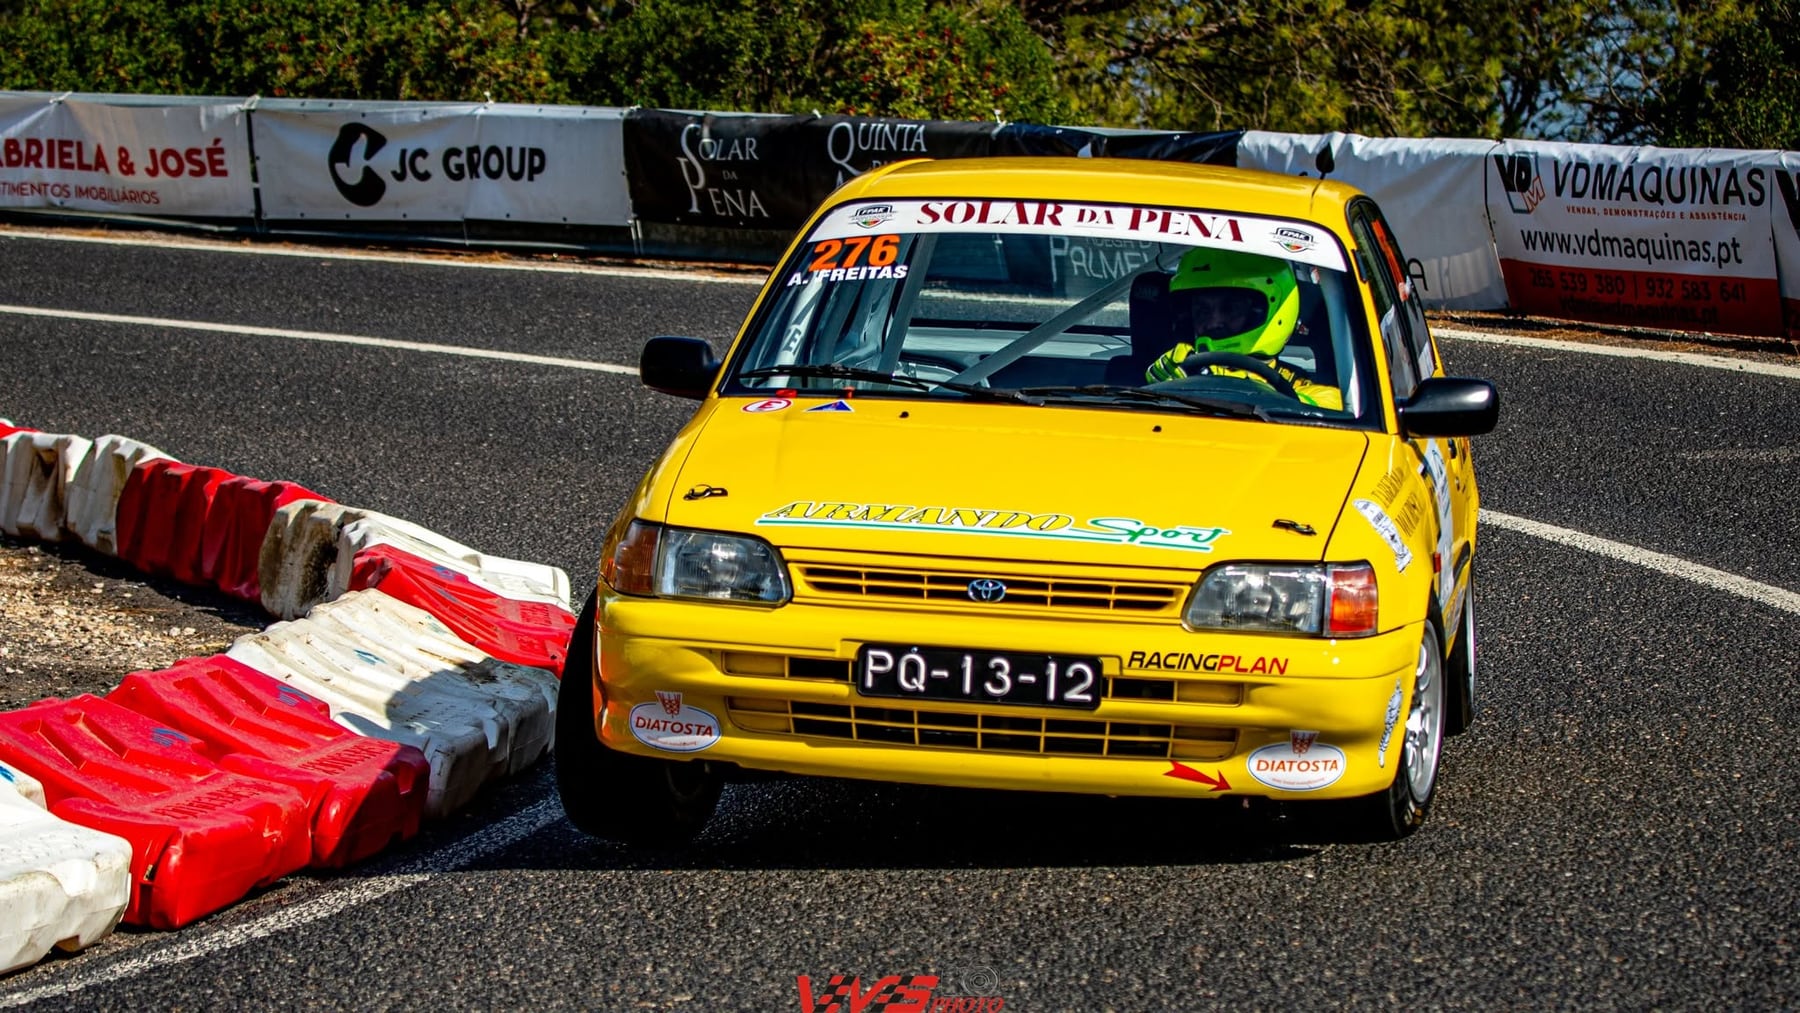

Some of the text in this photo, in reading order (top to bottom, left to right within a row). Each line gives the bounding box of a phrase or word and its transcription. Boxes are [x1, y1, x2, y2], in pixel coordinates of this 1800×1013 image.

[0, 137, 228, 178] BRIELA & JOSÉ
[391, 145, 546, 182] JC GROUP
[679, 123, 759, 192] SOLAR
[827, 121, 927, 175] QUINTA
[75, 184, 160, 204] IMOBILIÁRIOS
[676, 157, 768, 218] PENA
[722, 170, 738, 181] DA
[1554, 155, 1765, 207] VDMÁQUINAS
[917, 201, 1063, 226] SOLAR
[1077, 208, 1114, 225] DA
[1128, 208, 1244, 242] PENA
[809, 234, 900, 271] 276
[1520, 229, 1743, 268] www.vdmaquinas.pt
[787, 265, 908, 287] A. FREITAS
[1559, 273, 1588, 292] 539
[1595, 276, 1626, 296] 380
[1646, 278, 1674, 298] 932
[1681, 280, 1711, 300] 583
[1718, 282, 1746, 303] 641
[766, 501, 1230, 546] ARMANDO Sport
[864, 650, 1095, 702] PQ-13-12
[1128, 651, 1289, 675] RACINGPLAN
[635, 716, 714, 737] DIATOSTA
[1256, 758, 1339, 773] DIATOSTA
